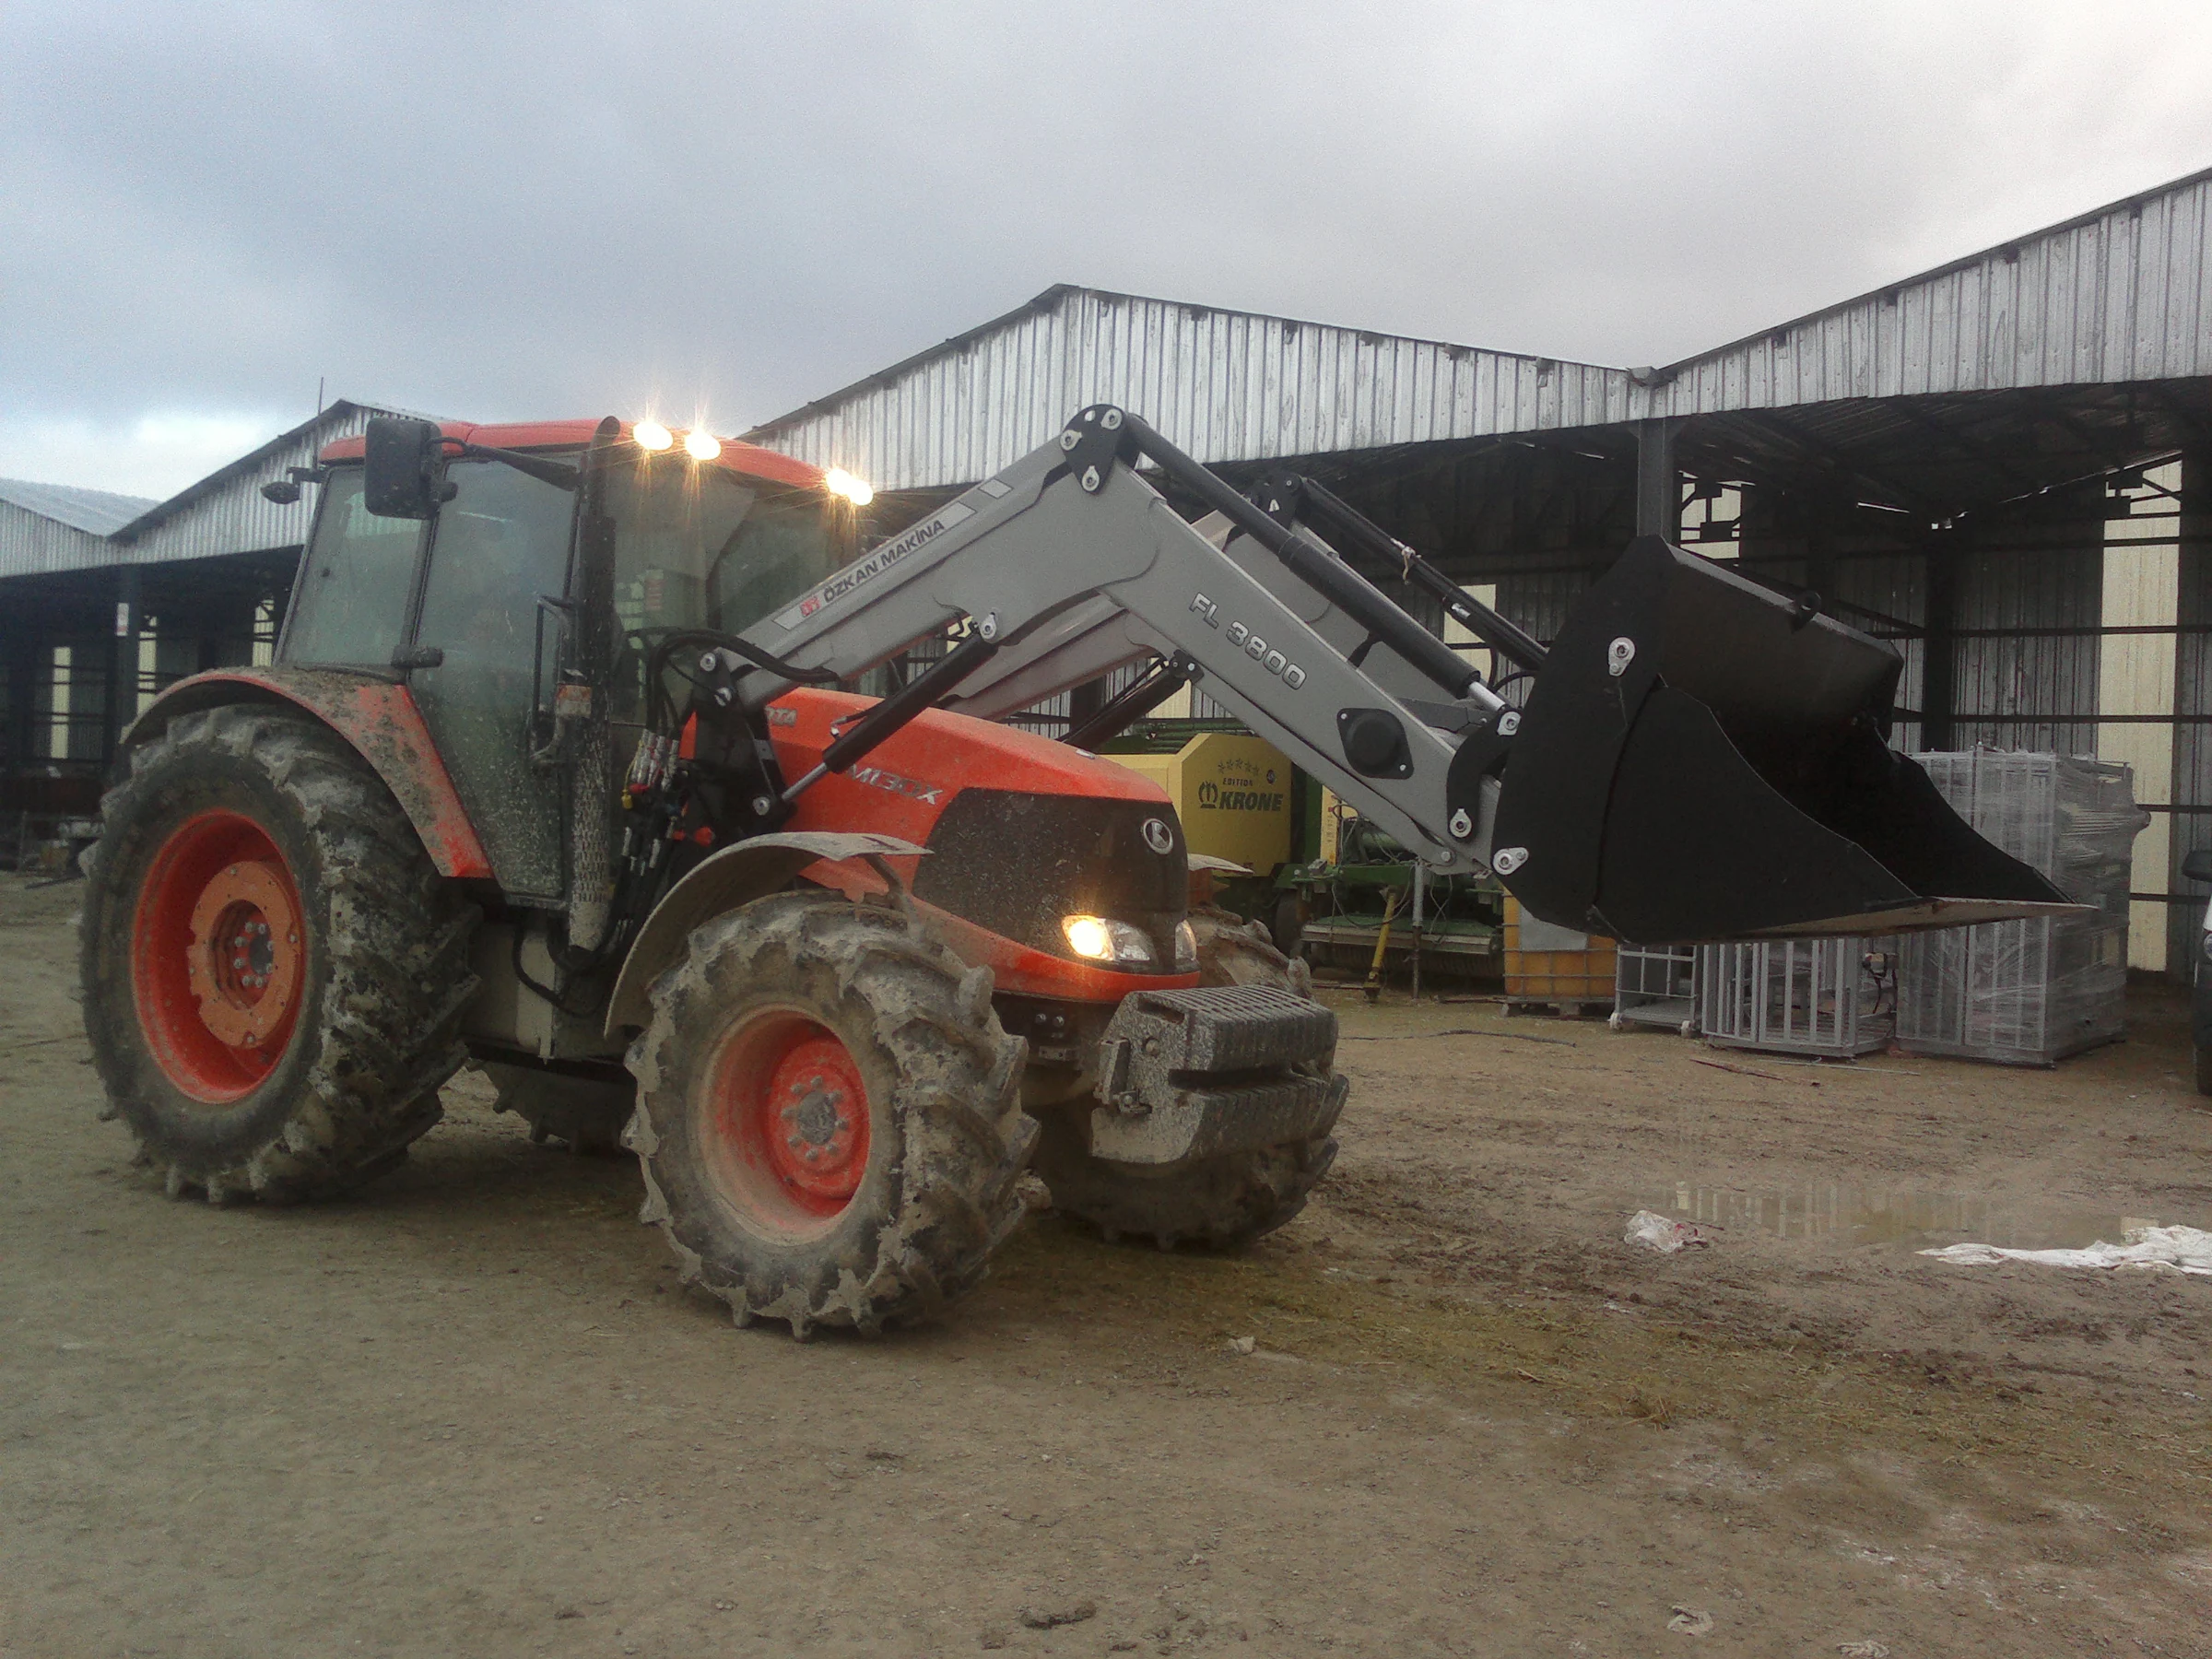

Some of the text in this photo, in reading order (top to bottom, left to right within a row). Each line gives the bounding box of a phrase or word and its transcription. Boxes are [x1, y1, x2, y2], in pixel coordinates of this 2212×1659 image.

[824, 519, 946, 603] ÖZKAN MAKİNA
[1189, 592, 1307, 690] FL 3800
[1219, 792, 1284, 811] KRONE
[1222, 778, 1253, 787] EDITION
